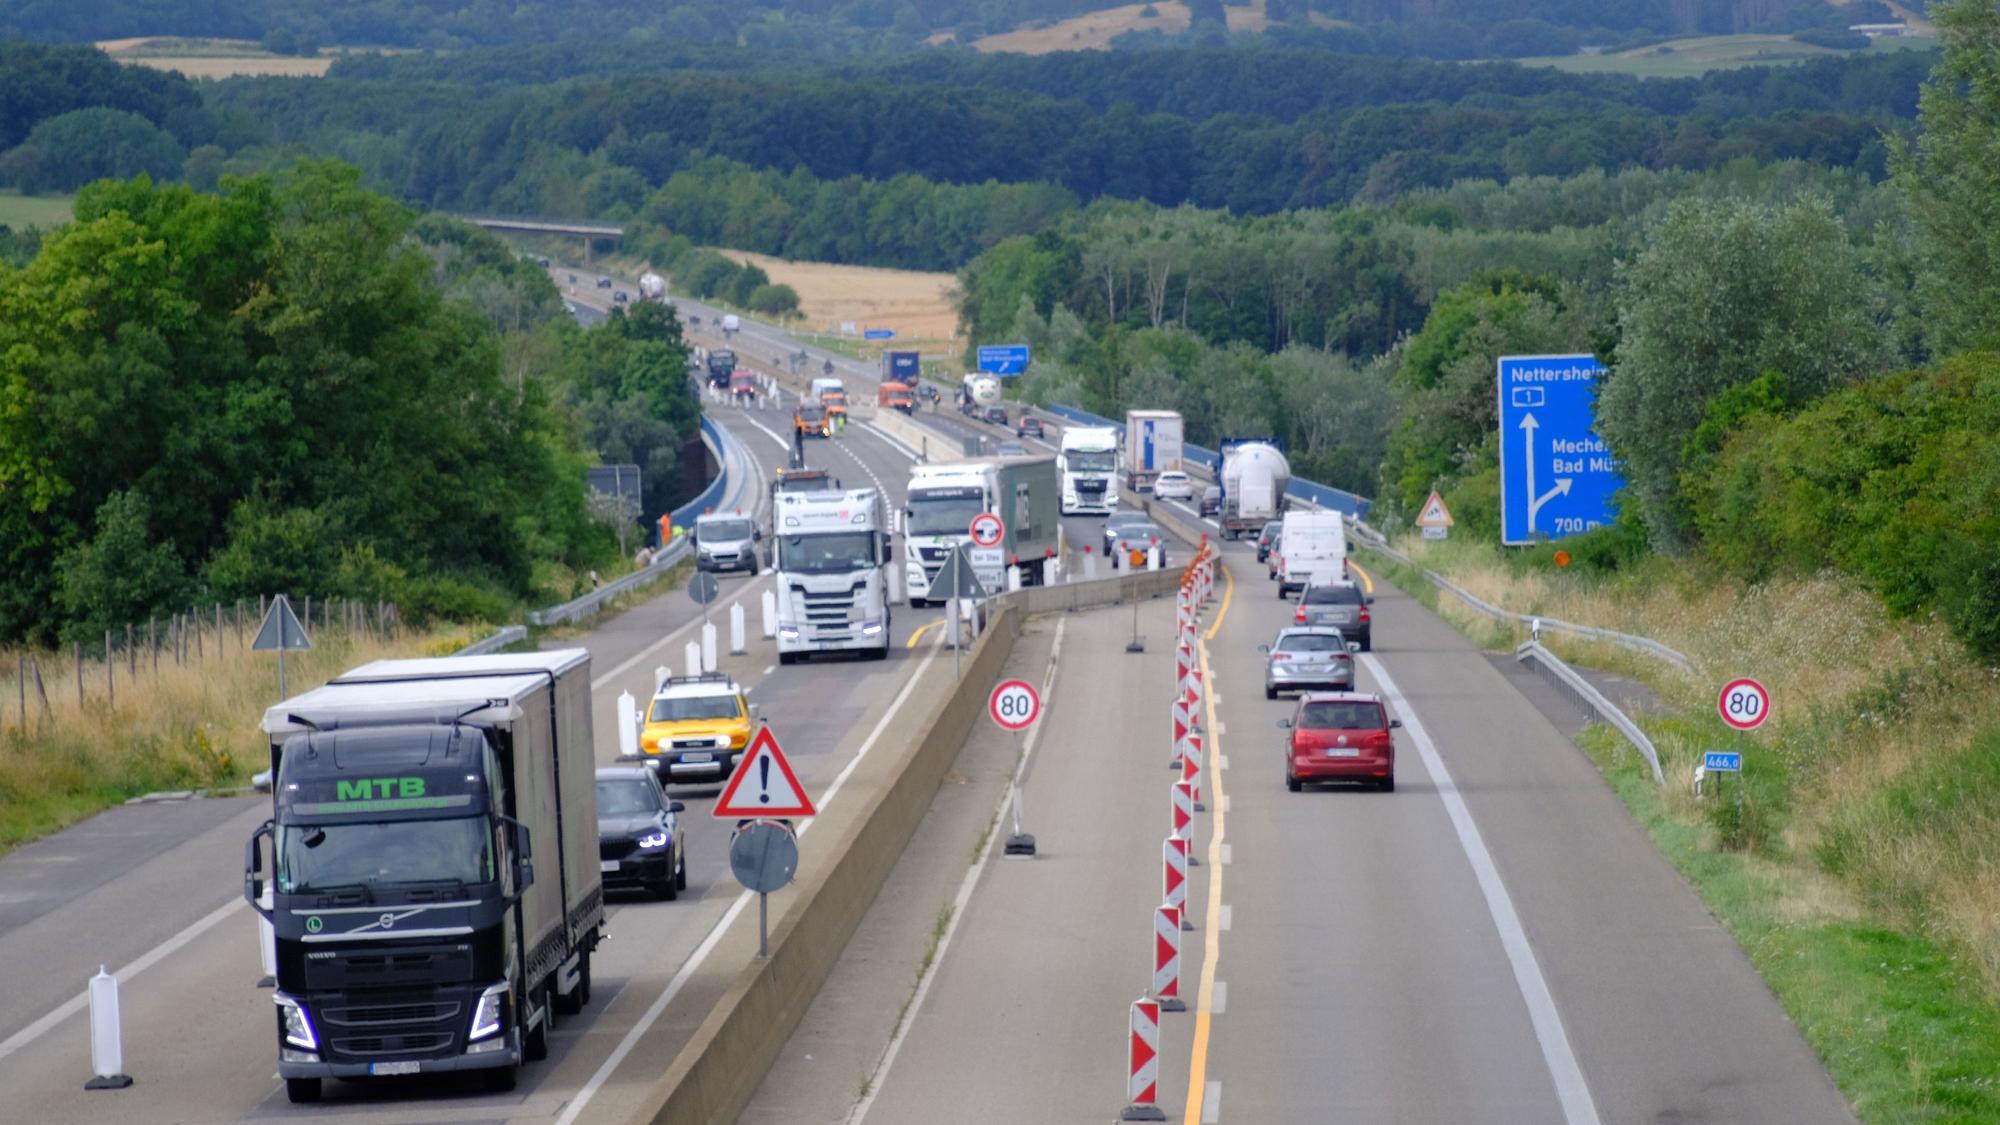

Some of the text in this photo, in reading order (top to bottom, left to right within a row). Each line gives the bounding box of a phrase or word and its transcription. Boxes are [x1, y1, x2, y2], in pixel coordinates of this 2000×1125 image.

[1525, 390, 1532, 403] 1
[1552, 438, 1608, 453] Meche
[1553, 458, 1583, 473] Bad
[1554, 518, 1583, 532] 700
[1001, 695, 1028, 716] 80
[1730, 692, 1758, 715] 80
[337, 776, 426, 801] MTB
